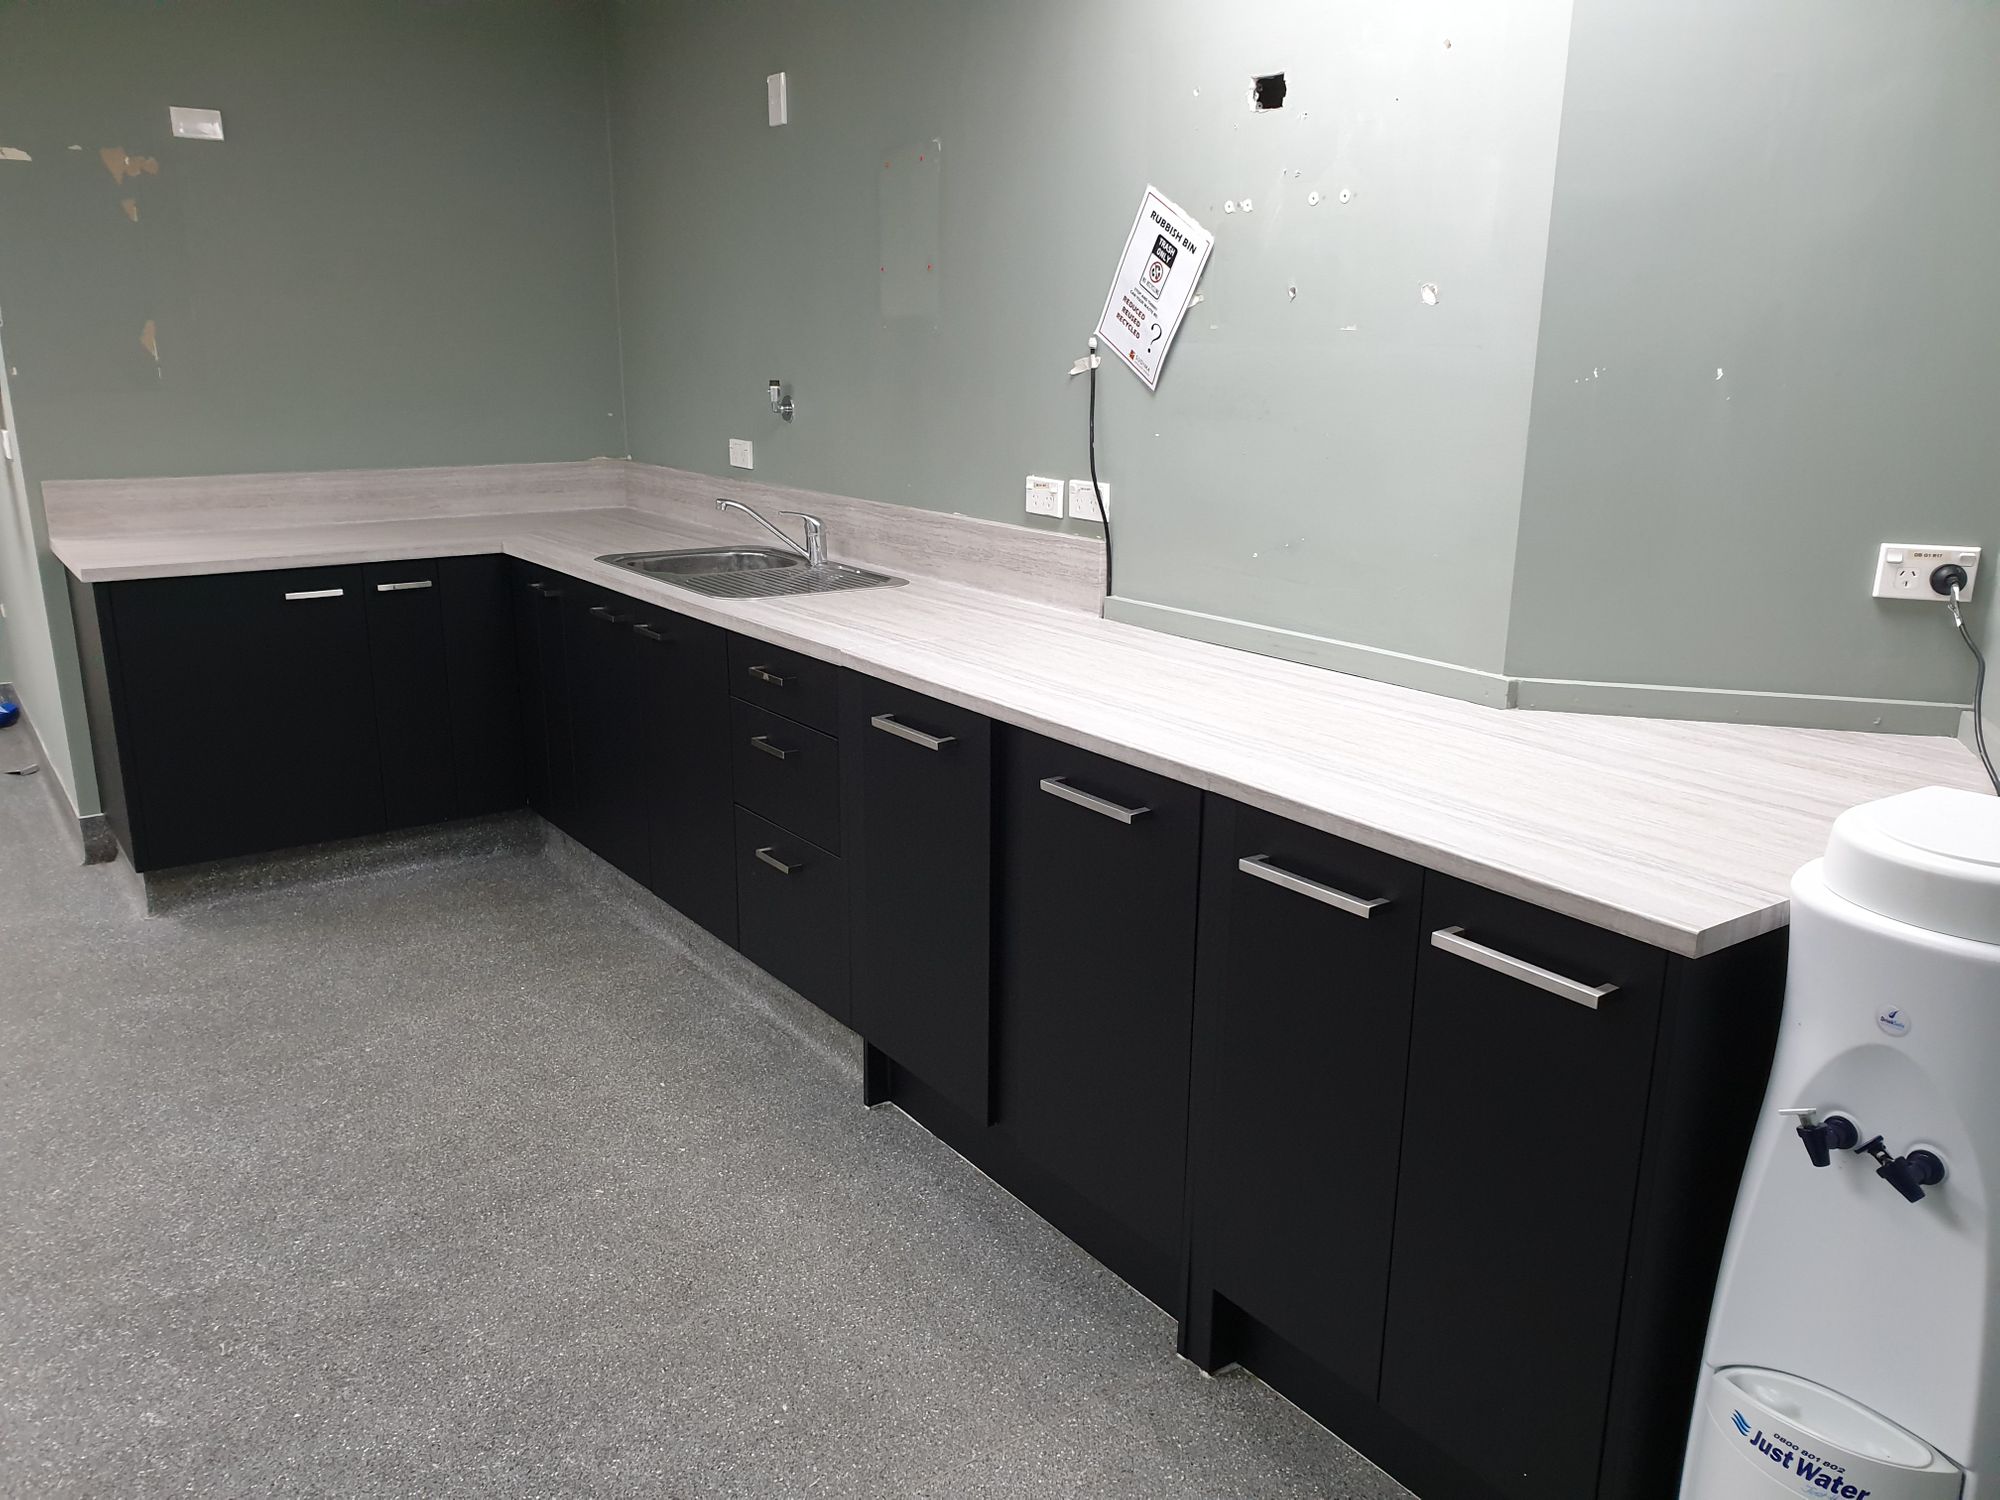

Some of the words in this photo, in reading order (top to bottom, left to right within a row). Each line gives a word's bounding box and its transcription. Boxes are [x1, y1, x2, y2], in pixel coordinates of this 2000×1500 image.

[1150, 210, 1183, 242] RUBBISH
[1182, 237, 1197, 254] BIN
[1156, 247, 1172, 263] ONLY
[1159, 238, 1176, 256] TRASH
[1122, 306, 1141, 328] REUSED
[1123, 295, 1146, 321] REDUCED
[1116, 312, 1140, 339] RECYCLED
[1750, 1430, 1794, 1469] Just
[1795, 1456, 1871, 1500] Water
[1773, 1433, 1799, 1451] 0800
[1801, 1450, 1821, 1463] 801
[1822, 1461, 1846, 1474] 802
